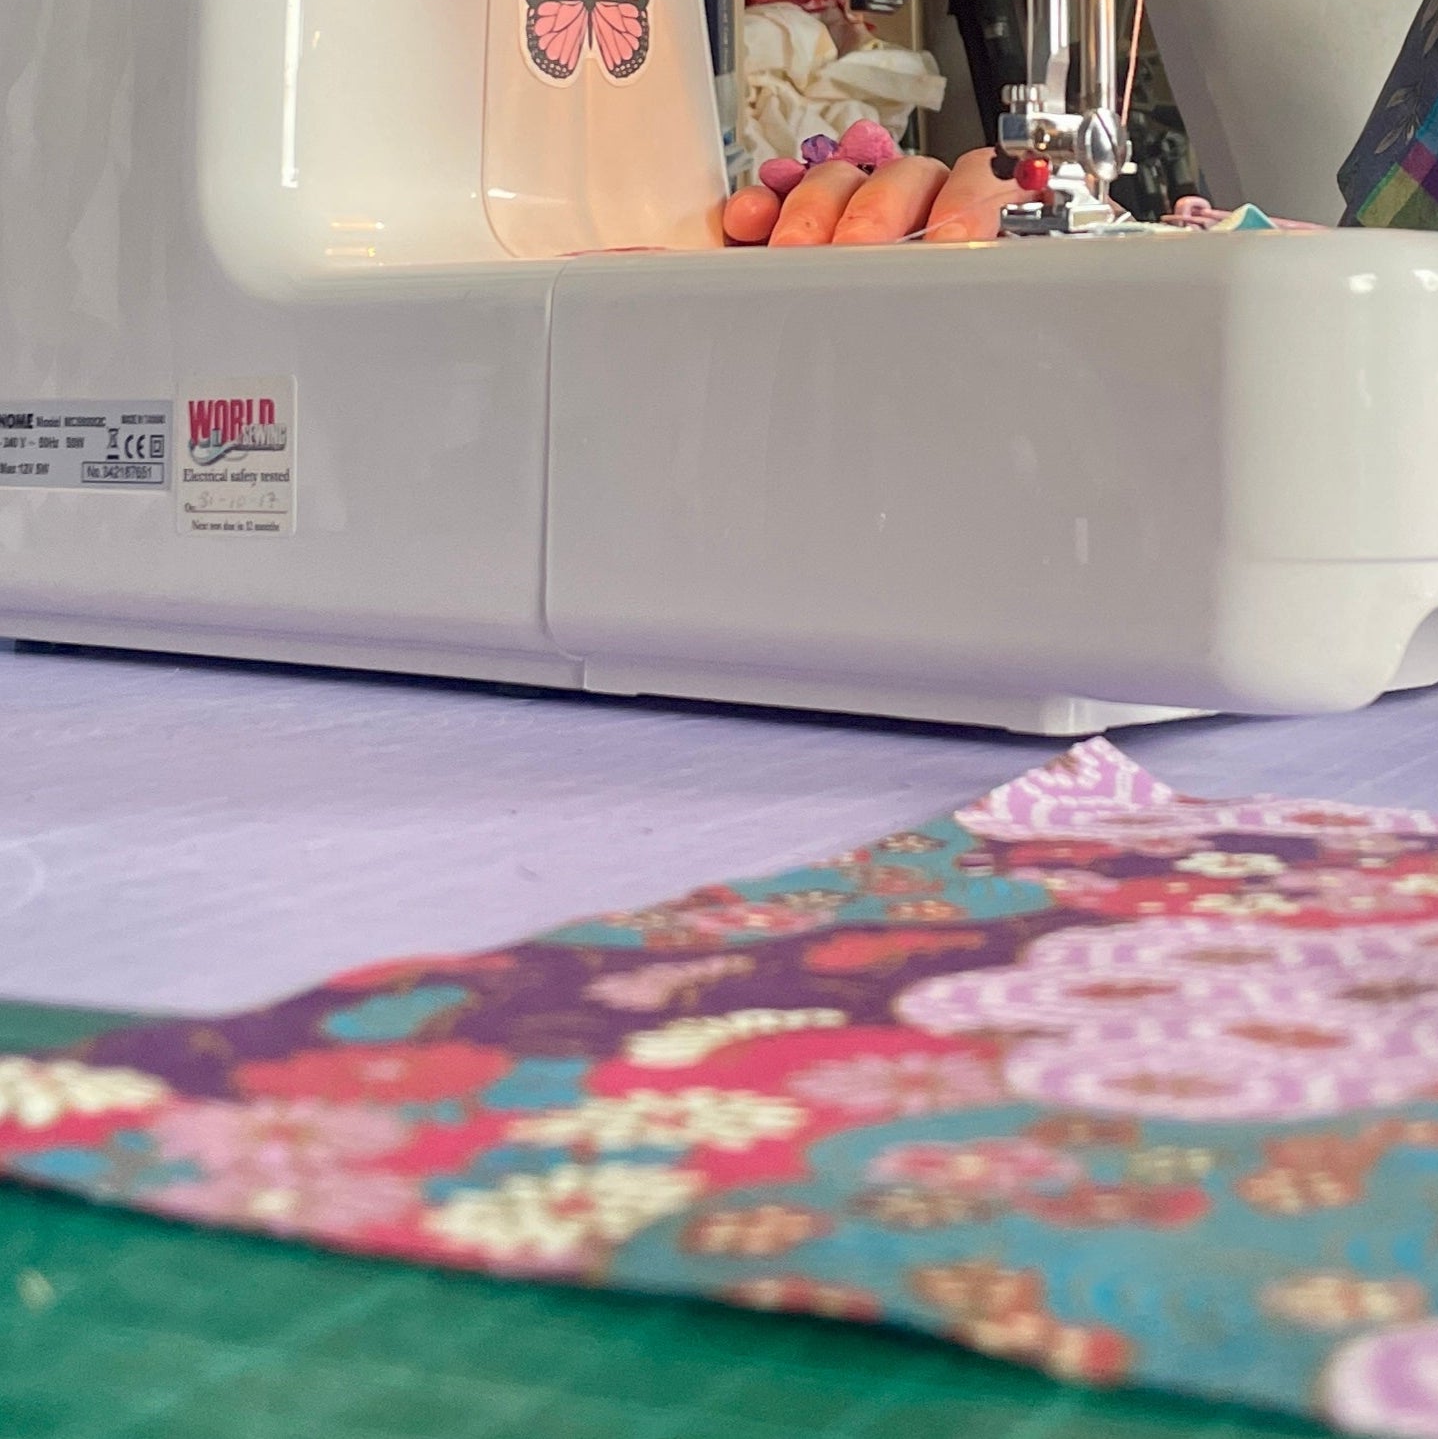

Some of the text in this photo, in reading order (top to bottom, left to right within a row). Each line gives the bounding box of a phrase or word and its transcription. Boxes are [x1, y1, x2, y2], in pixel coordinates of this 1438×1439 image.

[188, 398, 276, 447] WORLD
[241, 423, 287, 445] SEWING
[183, 468, 291, 487] Electrical safety tested
